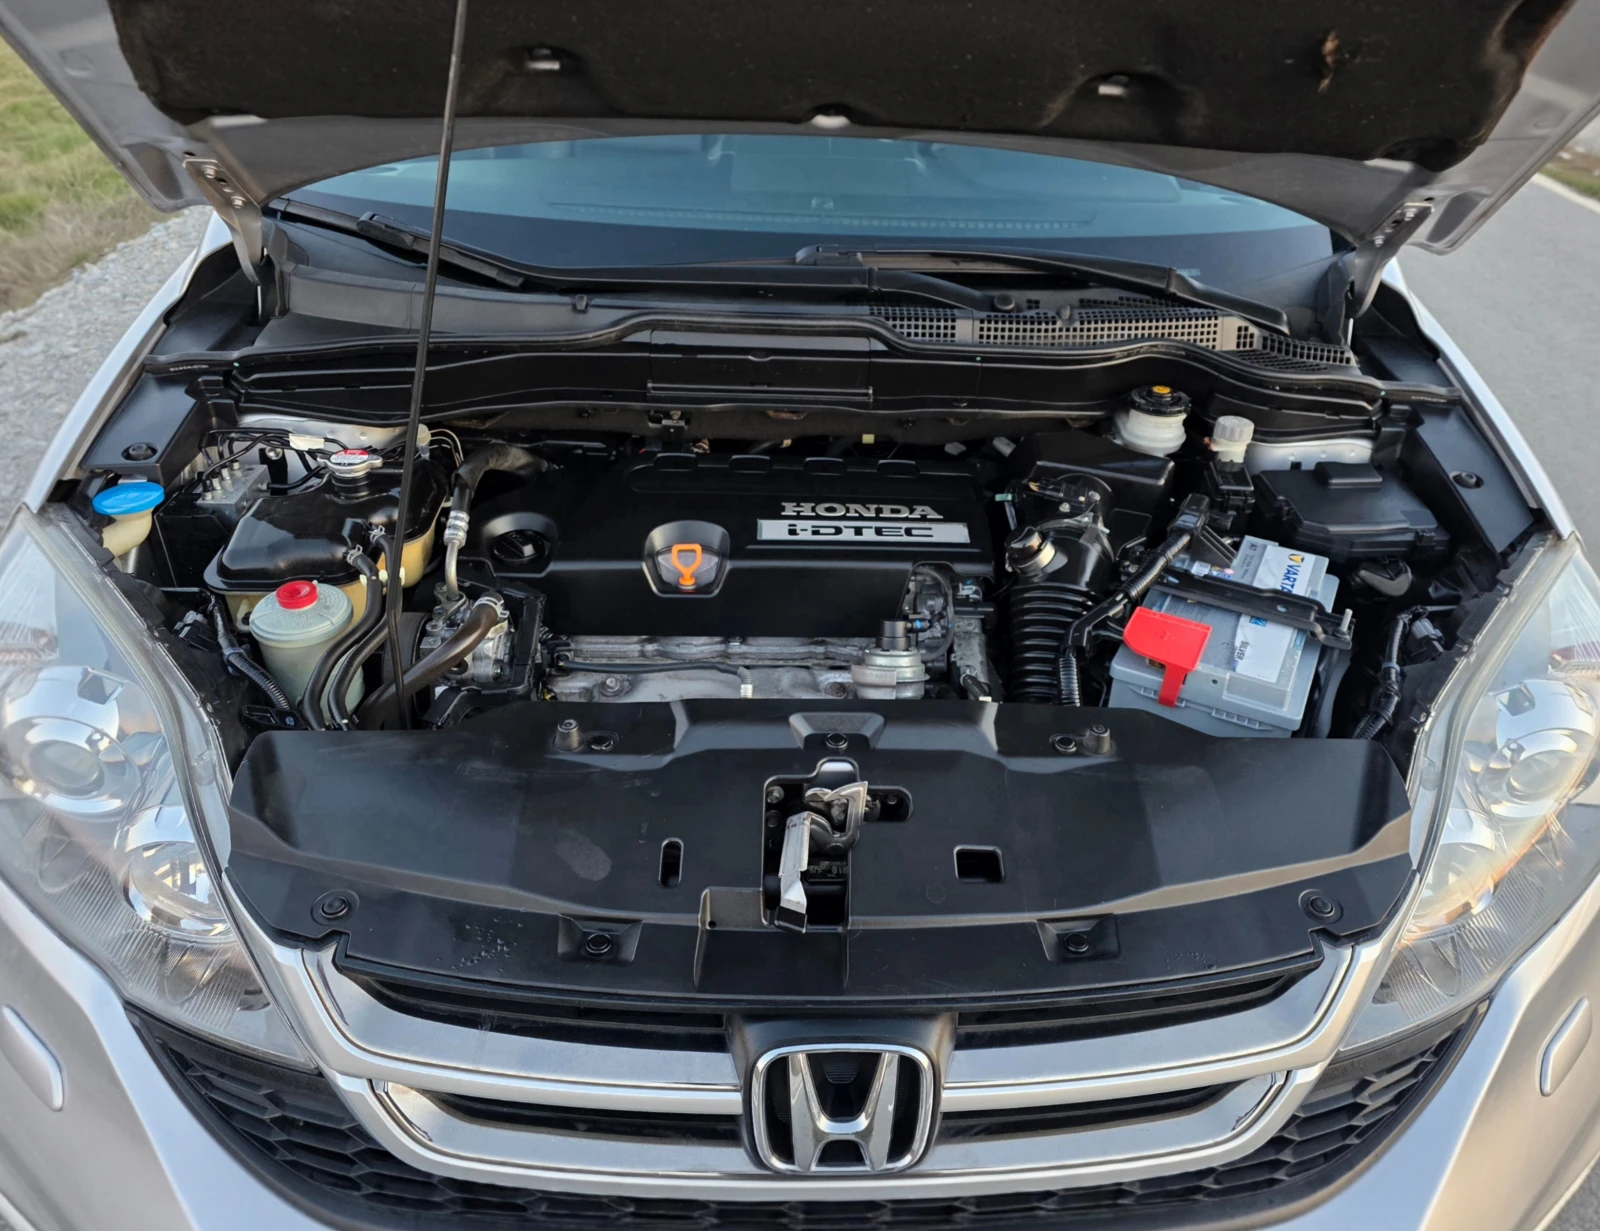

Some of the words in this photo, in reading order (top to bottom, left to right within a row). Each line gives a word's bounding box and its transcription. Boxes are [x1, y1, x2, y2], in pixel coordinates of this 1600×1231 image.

[781, 502, 943, 519] HONDA
[788, 523, 934, 538] i-DTEC
[1280, 564, 1301, 594] VARTA
[1235, 640, 1249, 661] SILVER
